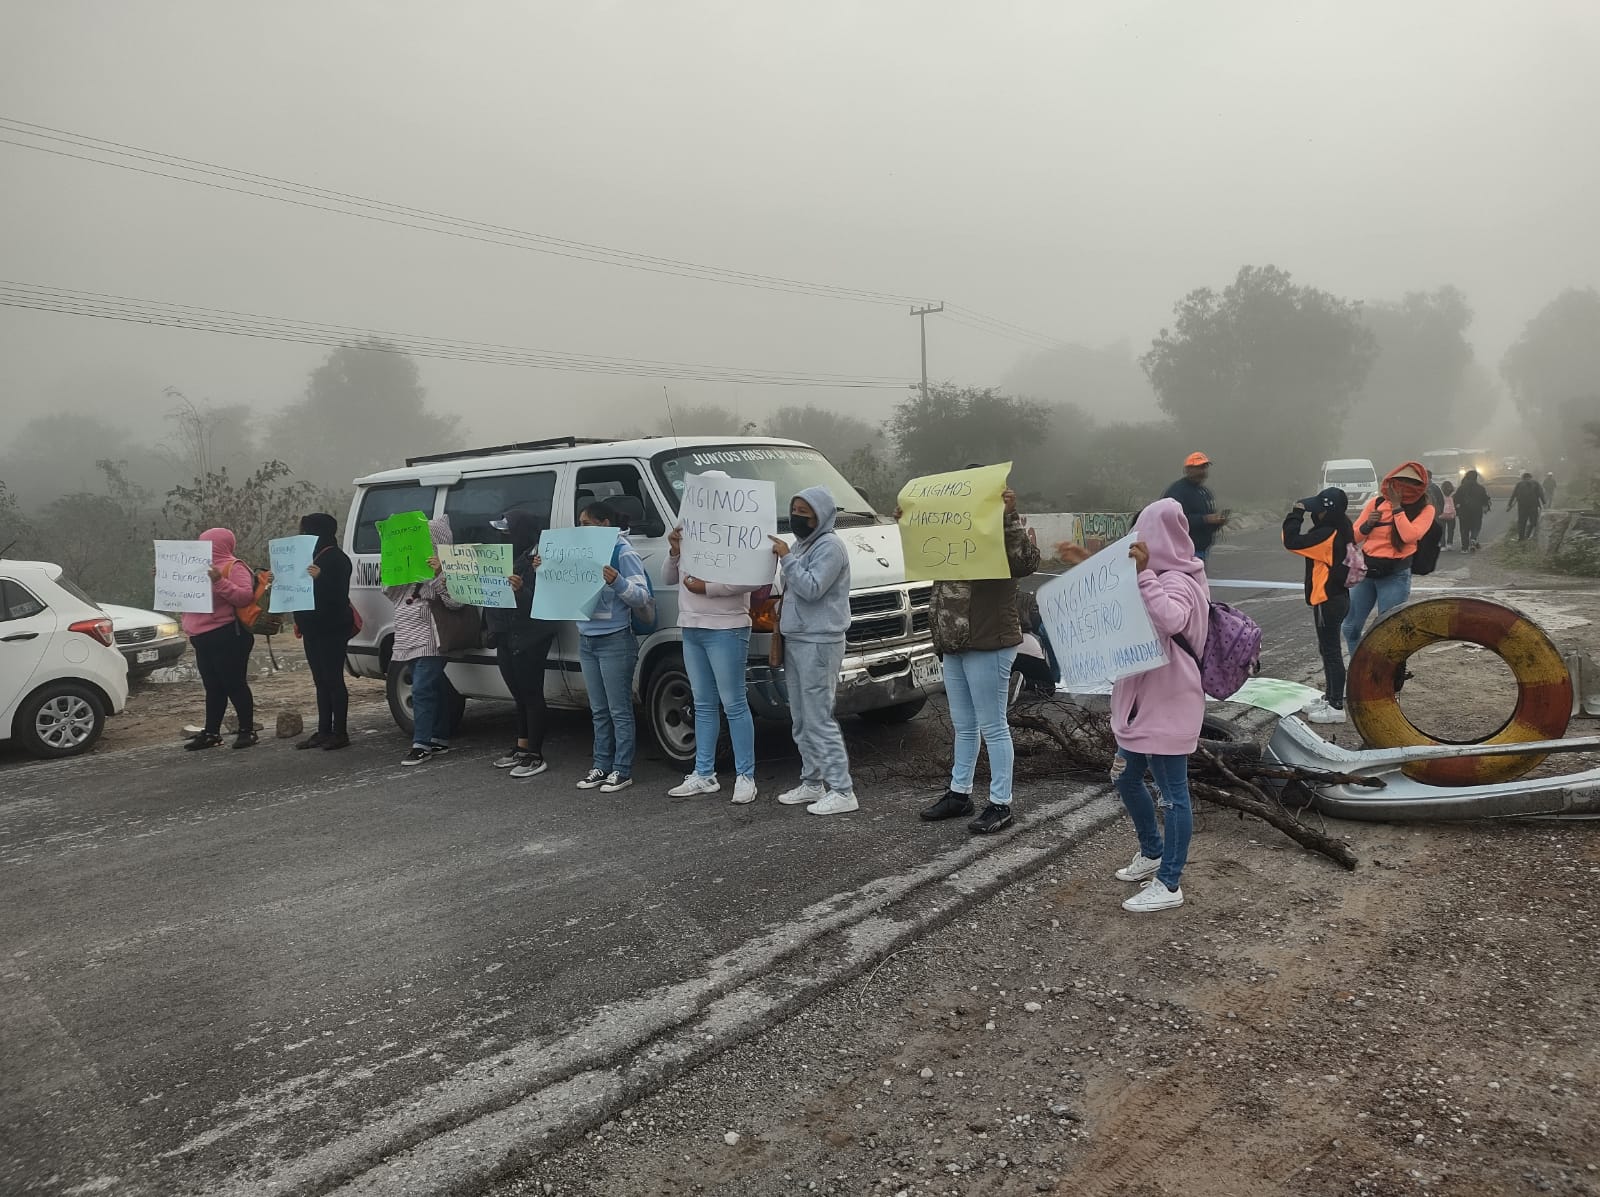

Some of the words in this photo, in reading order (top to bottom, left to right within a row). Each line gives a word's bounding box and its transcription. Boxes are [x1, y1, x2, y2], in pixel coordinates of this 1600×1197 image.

[692, 451, 741, 466] JUNTOS
[740, 449, 775, 461] HASTA
[684, 487, 759, 512] XIGIMOS
[907, 481, 972, 498] EXIGIMOS
[909, 510, 972, 530] MAESTROS
[682, 518, 762, 549] MAESTRO
[692, 551, 737, 568] #SEP
[922, 536, 976, 567] SEP
